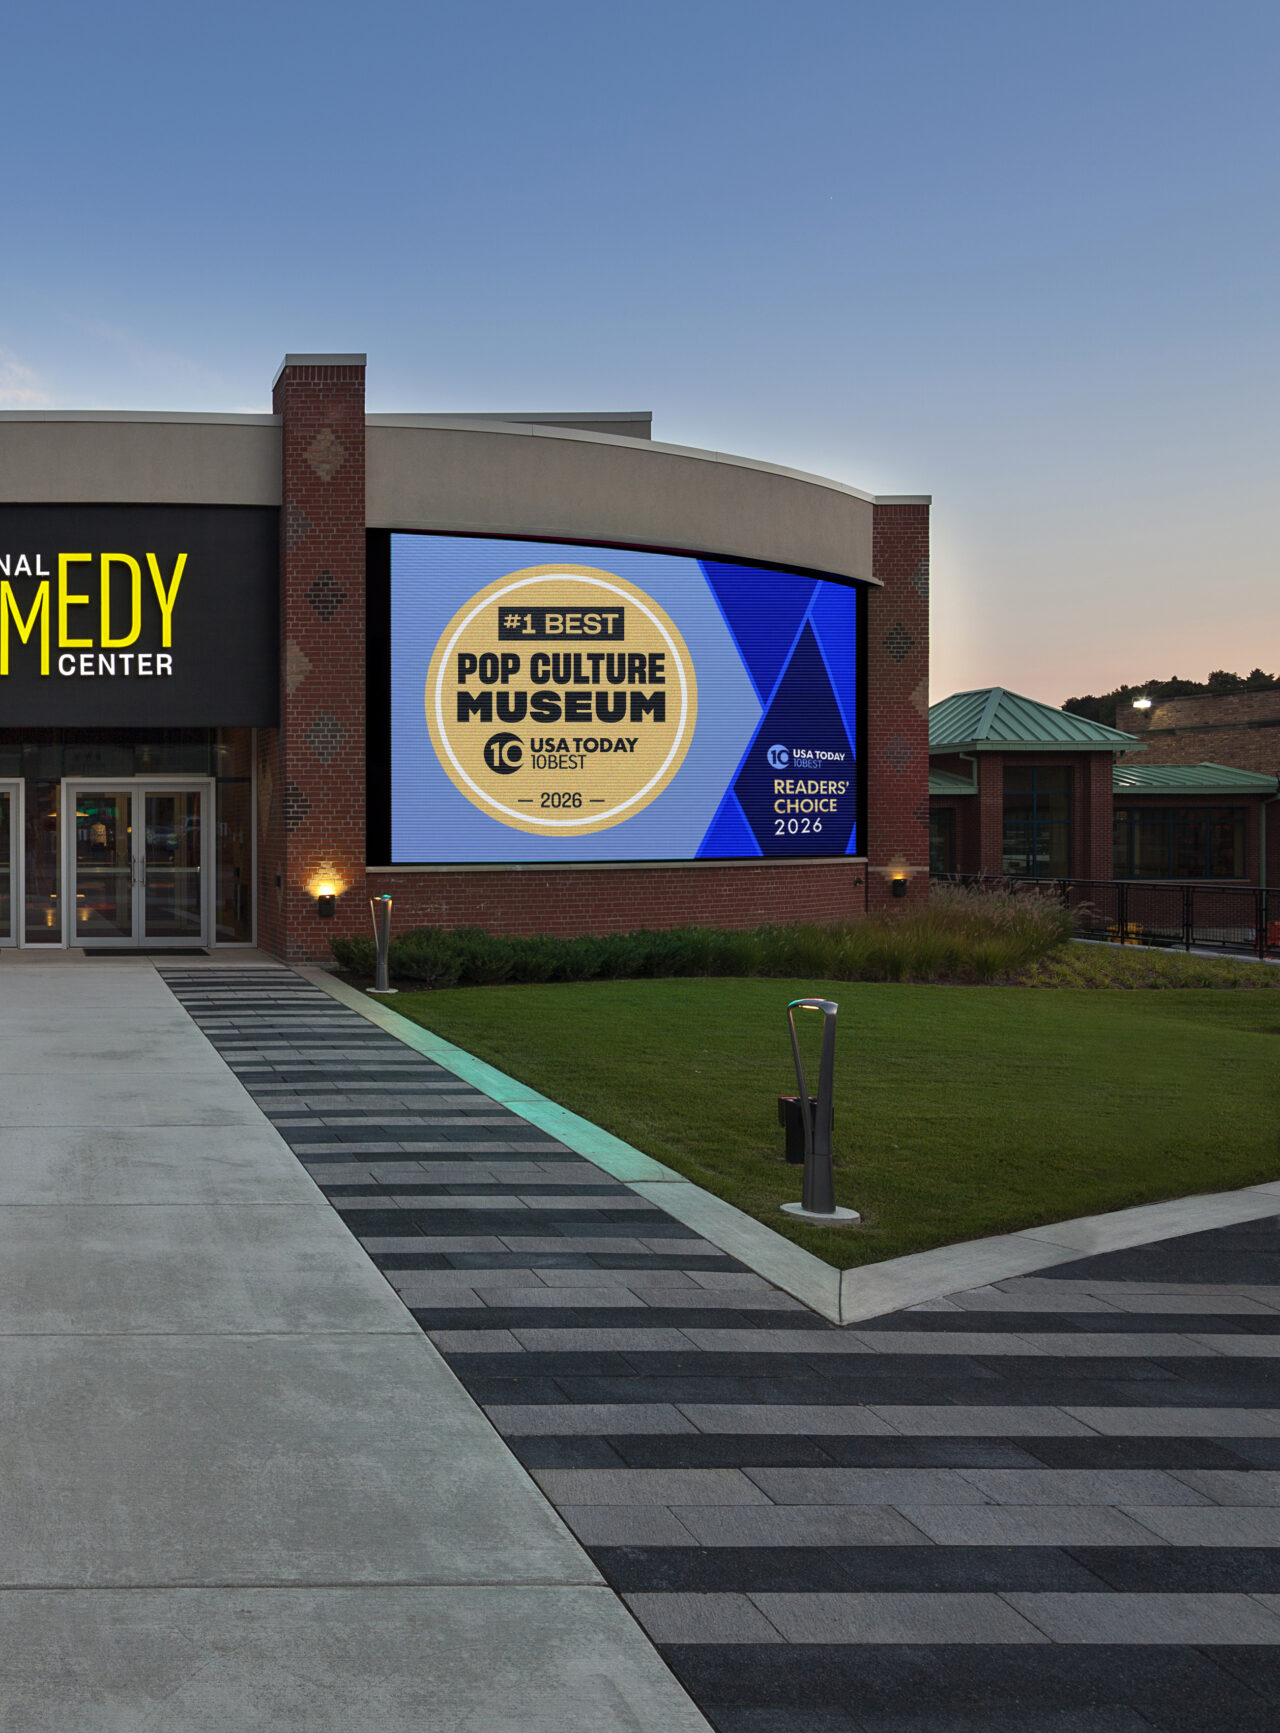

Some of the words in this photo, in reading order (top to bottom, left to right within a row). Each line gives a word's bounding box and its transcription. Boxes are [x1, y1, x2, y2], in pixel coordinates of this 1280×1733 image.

[503, 613, 536, 634] #1
[545, 613, 619, 635] BEST
[58, 653, 173, 676] CENTER
[457, 652, 521, 685] POP
[530, 652, 666, 685] CULTURE
[457, 690, 666, 724] MUSEUM
[530, 737, 570, 753] USA
[572, 737, 639, 753] TODAY
[530, 754, 587, 770] 10BEST
[792, 748, 813, 759] USA
[814, 750, 845, 761] TODAY
[793, 758, 823, 769] 10BEST
[774, 779, 849, 795] READERS'
[540, 792, 583, 808] 2026
[774, 798, 838, 814] CHOICE
[774, 817, 823, 836] 2026
